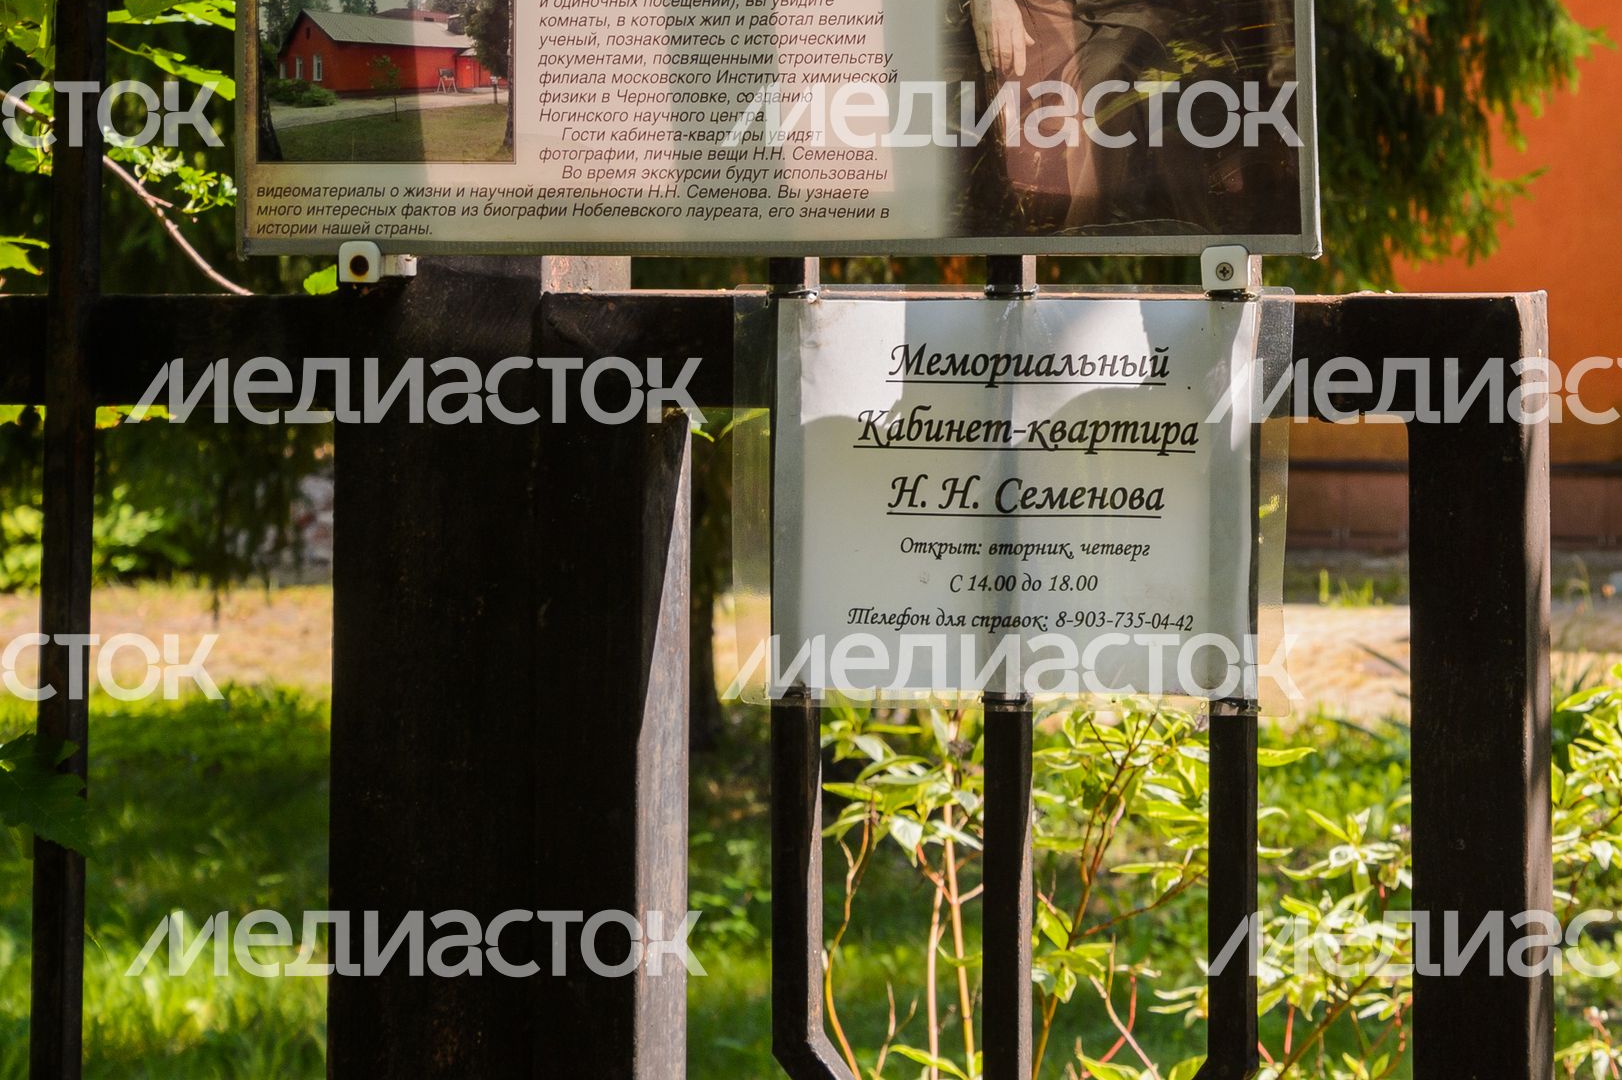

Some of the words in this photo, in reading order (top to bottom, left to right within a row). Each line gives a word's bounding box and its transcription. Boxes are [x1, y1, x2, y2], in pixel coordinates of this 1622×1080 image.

[540, 16, 610, 29] комнаты,
[617, 16, 625, 26] в
[631, 16, 696, 30] которых
[700, 16, 730, 26] жил
[736, 16, 745, 26] и
[749, 12, 813, 29] работал
[819, 11, 883, 25] великий
[538, 32, 600, 49] ученый,
[607, 35, 725, 46] познакомитесь
[731, 34, 739, 45] с
[744, 34, 866, 48] историческими
[538, 54, 646, 68] документами,
[653, 54, 773, 67] посвященными
[778, 53, 893, 68] строительству
[539, 71, 606, 87] филиала
[612, 73, 711, 84] московского
[716, 70, 796, 84] Института
[801, 69, 897, 83] химической
[539, 90, 596, 106] физики
[602, 93, 610, 103] в
[617, 89, 730, 106] Черноголовке,
[736, 91, 812, 105] созданию
[539, 108, 628, 122] Ногинского
[633, 111, 705, 126] научного
[562, 127, 605, 141] Гости
[611, 127, 766, 146] кабинета-квартиры
[768, 130, 824, 144] увидят
[539, 147, 638, 164] фотографии,
[644, 150, 702, 160] личные
[707, 150, 748, 163] вещи
[793, 146, 877, 161] Семенова.
[562, 165, 582, 179] Во
[587, 169, 636, 182] время
[641, 169, 721, 183] экскурсии
[726, 165, 769, 183] будут
[773, 169, 887, 180] использованы
[257, 187, 385, 200] видеоматериалы
[390, 187, 399, 197] о
[403, 187, 451, 197] жизни
[456, 187, 465, 197] и
[470, 184, 533, 201] научной
[537, 188, 643, 200] деятельности
[687, 184, 771, 198] Семенова.
[778, 185, 800, 198] Вы
[805, 188, 869, 202] узнаете
[257, 205, 302, 216] много
[307, 205, 397, 219] интересных
[401, 203, 456, 219] фактов
[461, 206, 478, 216] из
[484, 203, 567, 220] биографии
[573, 203, 682, 217] Нобелевского
[686, 207, 762, 221] лауреата,
[769, 207, 794, 217] его
[799, 207, 875, 218] значении
[881, 208, 889, 218] в
[257, 223, 317, 237] истории
[322, 221, 370, 235] нашей
[374, 224, 433, 237] страны.
[886, 343, 1169, 389] Мемориальный
[857, 405, 1199, 456] Кабинет-квартира
[888, 474, 928, 508] Н.
[938, 475, 980, 509] Н.
[995, 478, 1164, 514] Семенова
[901, 537, 982, 560] Открыт:
[989, 543, 1074, 561] вторник,
[1080, 544, 1150, 561] четверг
[950, 575, 963, 592] С
[968, 575, 1016, 592] 14.00
[1022, 573, 1041, 591] до
[1049, 575, 1098, 591] 18.00
[847, 607, 930, 631] Телефон
[936, 608, 966, 629] для
[972, 616, 1048, 634] справок:
[1056, 611, 1193, 631] 8-903-735-04-42
